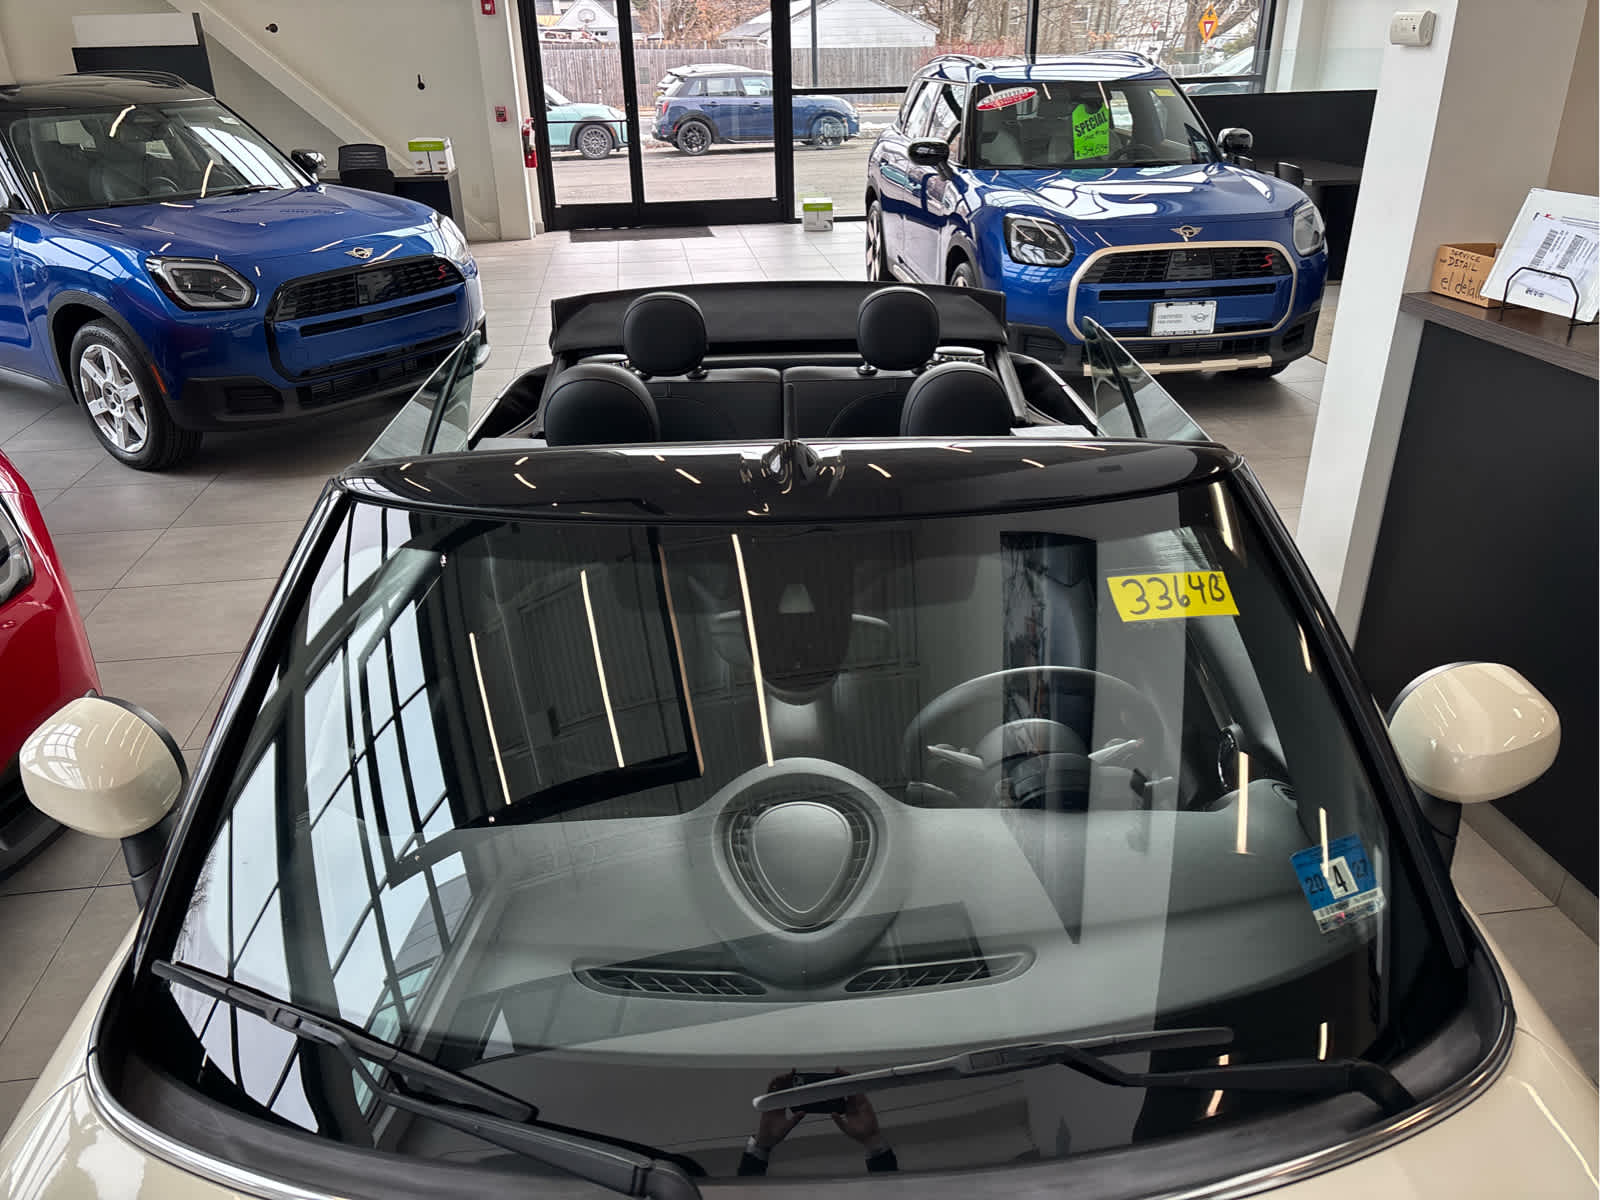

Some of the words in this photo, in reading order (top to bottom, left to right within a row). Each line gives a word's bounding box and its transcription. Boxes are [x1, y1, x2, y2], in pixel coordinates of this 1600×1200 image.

[1075, 111, 1107, 137] SPECIAL
[1260, 253, 1274, 268] S
[1447, 256, 1478, 272] DETAIL
[1450, 248, 1481, 263] SERVICE
[437, 264, 448, 280] S
[1441, 272, 1455, 292] el
[1121, 573, 1226, 615] 3364B
[1333, 865, 1349, 892] 4
